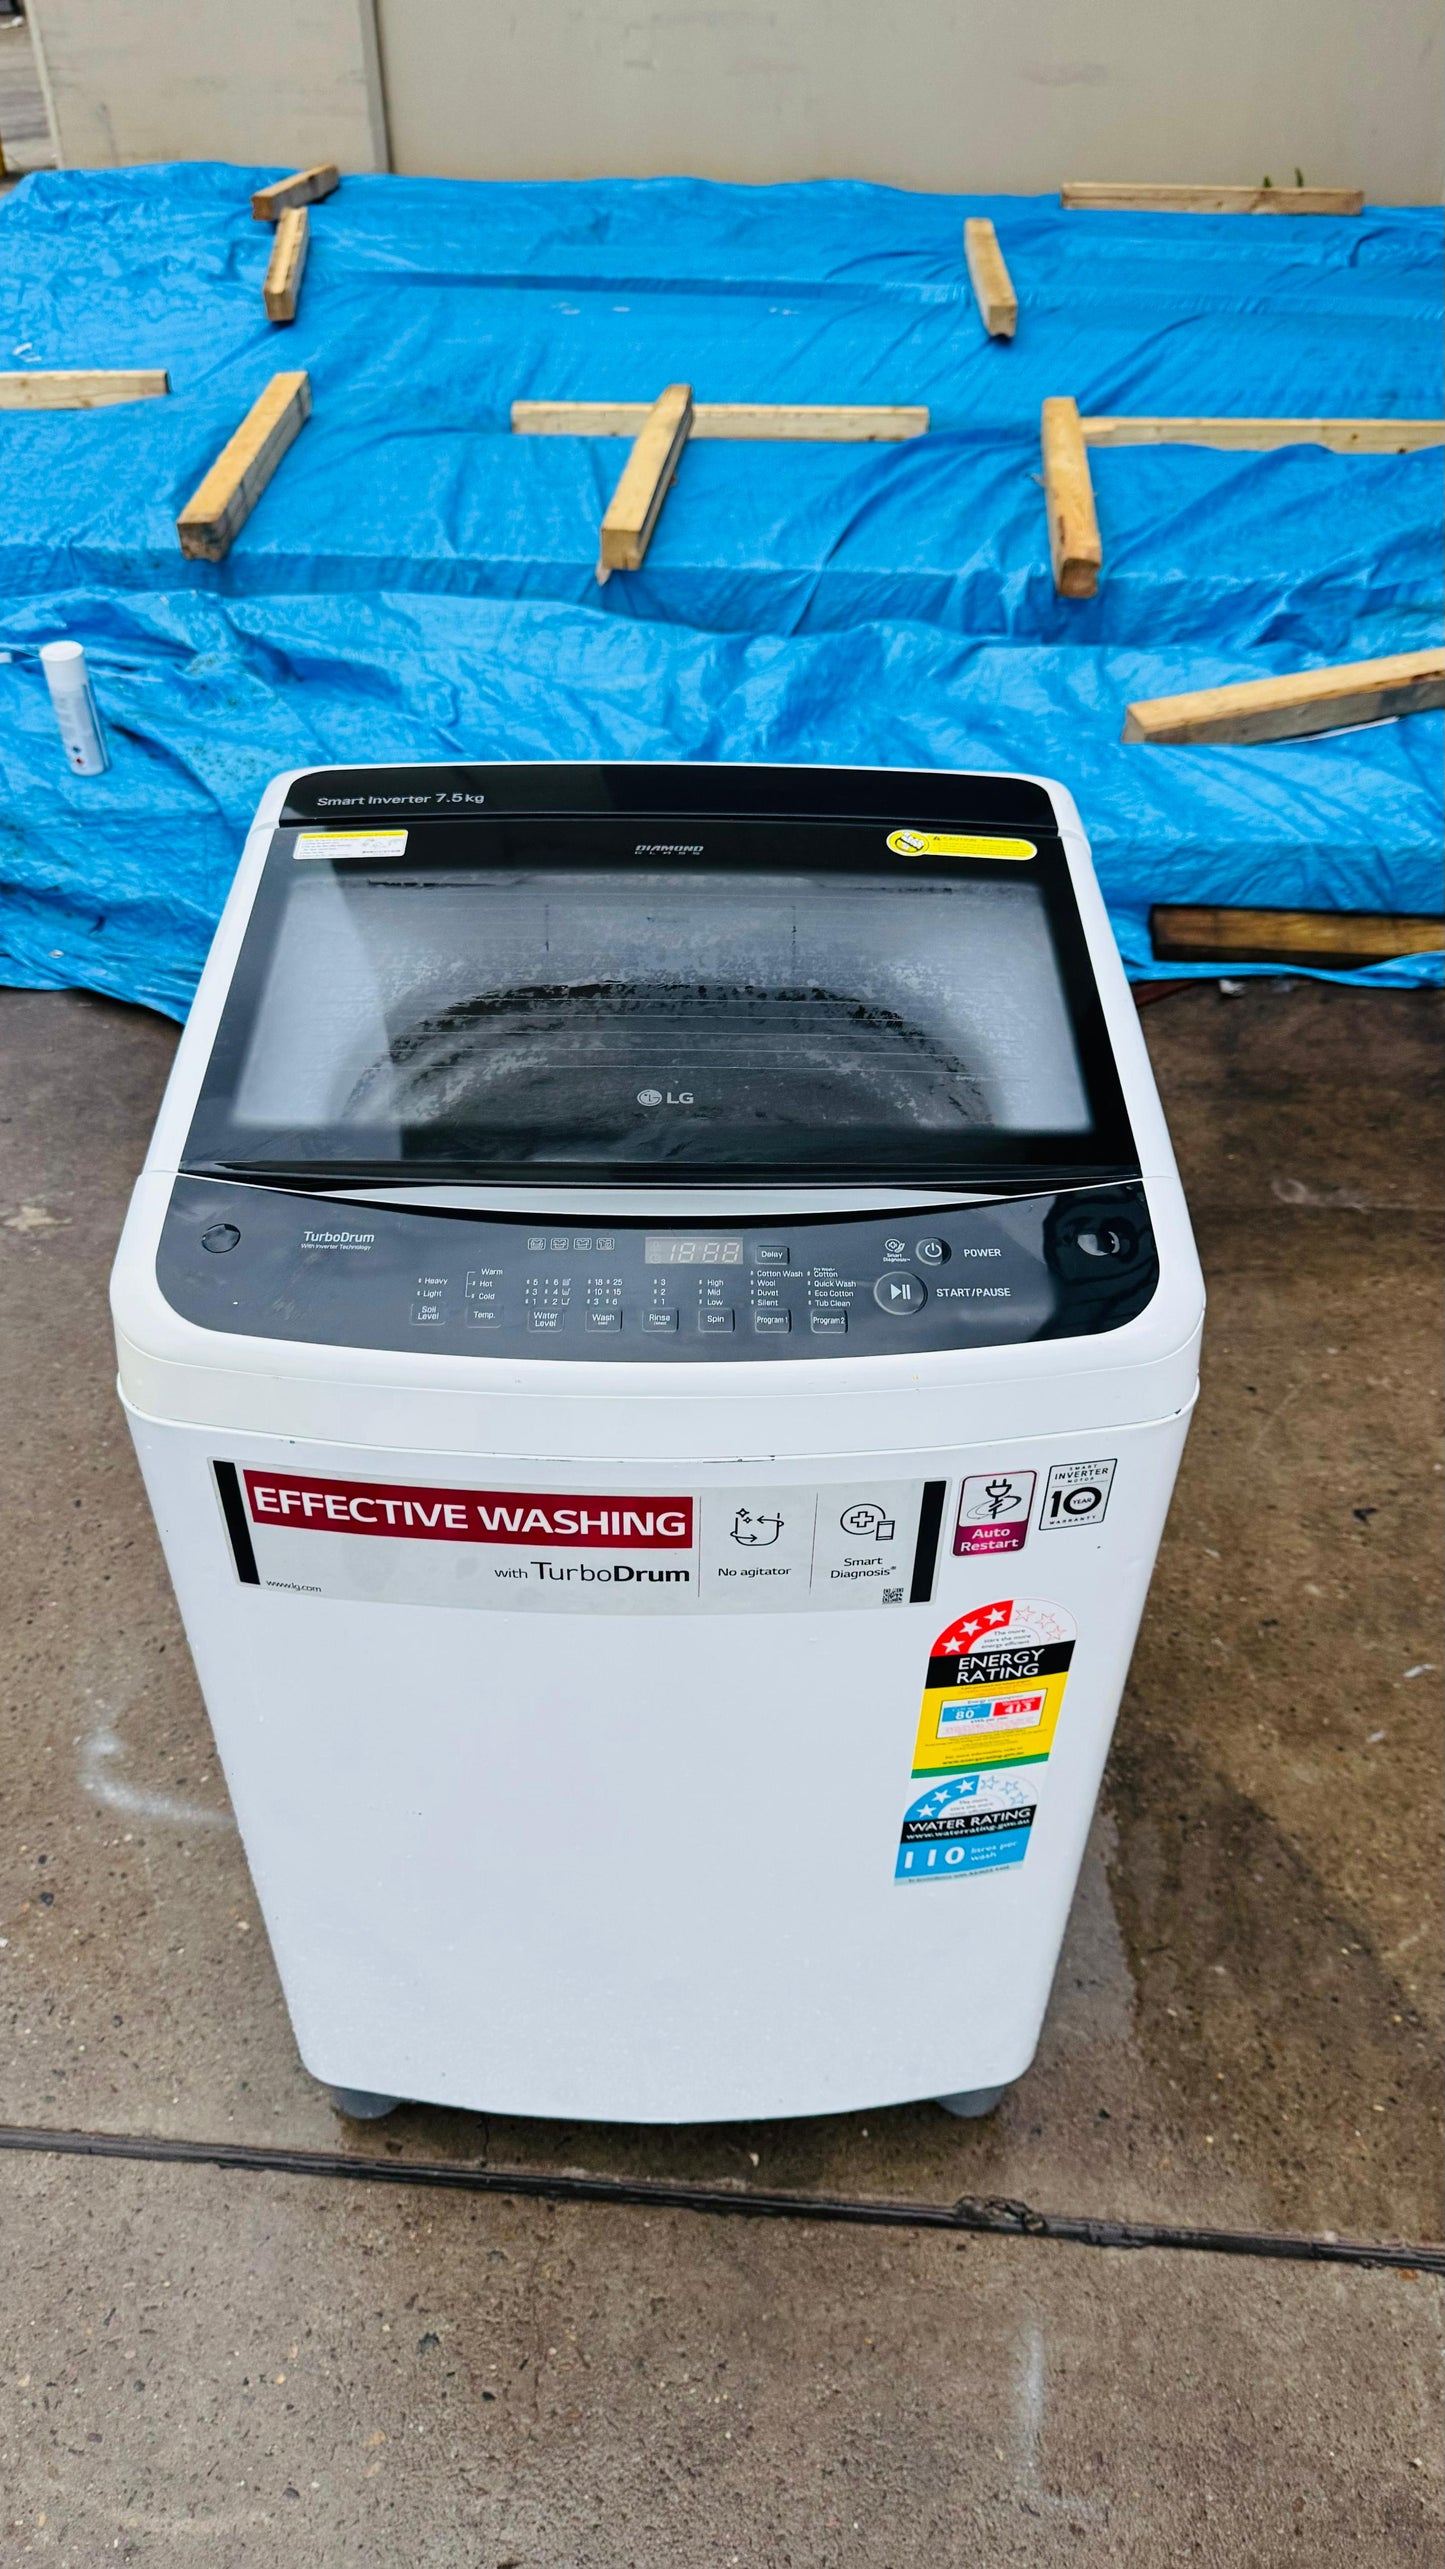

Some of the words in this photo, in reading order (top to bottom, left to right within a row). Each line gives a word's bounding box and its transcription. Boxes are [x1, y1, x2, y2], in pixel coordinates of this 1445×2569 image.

[317, 797, 365, 806] Smart
[368, 796, 431, 805] Inverter
[666, 1092, 694, 1104] LG
[304, 1231, 374, 1242] TurboDrum
[762, 1250, 782, 1259] Delay
[964, 1248, 1001, 1257] POWER
[936, 1288, 1011, 1297] START/PAUSE
[473, 1311, 495, 1319] Temp.
[649, 1313, 670, 1321] Rinse
[707, 1315, 724, 1323] Spin
[813, 1316, 840, 1325] Program
[1054, 1468, 1108, 1480] INVERTER
[1050, 1487, 1102, 1518] 10
[253, 1486, 468, 1530] EFFECTIVE
[478, 1506, 686, 1537] WASHING
[1050, 1516, 1096, 1524] WARRANTY
[972, 1528, 1010, 1539] Auto
[960, 1538, 1019, 1552] Restart
[844, 1557, 883, 1567] Smart
[494, 1566, 528, 1579] with
[531, 1561, 690, 1582] TurboDrum
[718, 1568, 737, 1577] No
[740, 1567, 792, 1578] agitator
[266, 1580, 321, 1592] www.lg.com
[958, 1649, 1045, 1670] ENERGY
[957, 1664, 1039, 1684] RATING
[956, 1710, 974, 1720] 80
[908, 1819, 965, 1832] WATER
[970, 1808, 1031, 1826] RATING
[906, 1819, 1030, 1840] www.waterrating.gov.au
[971, 1852, 997, 1861] wash
